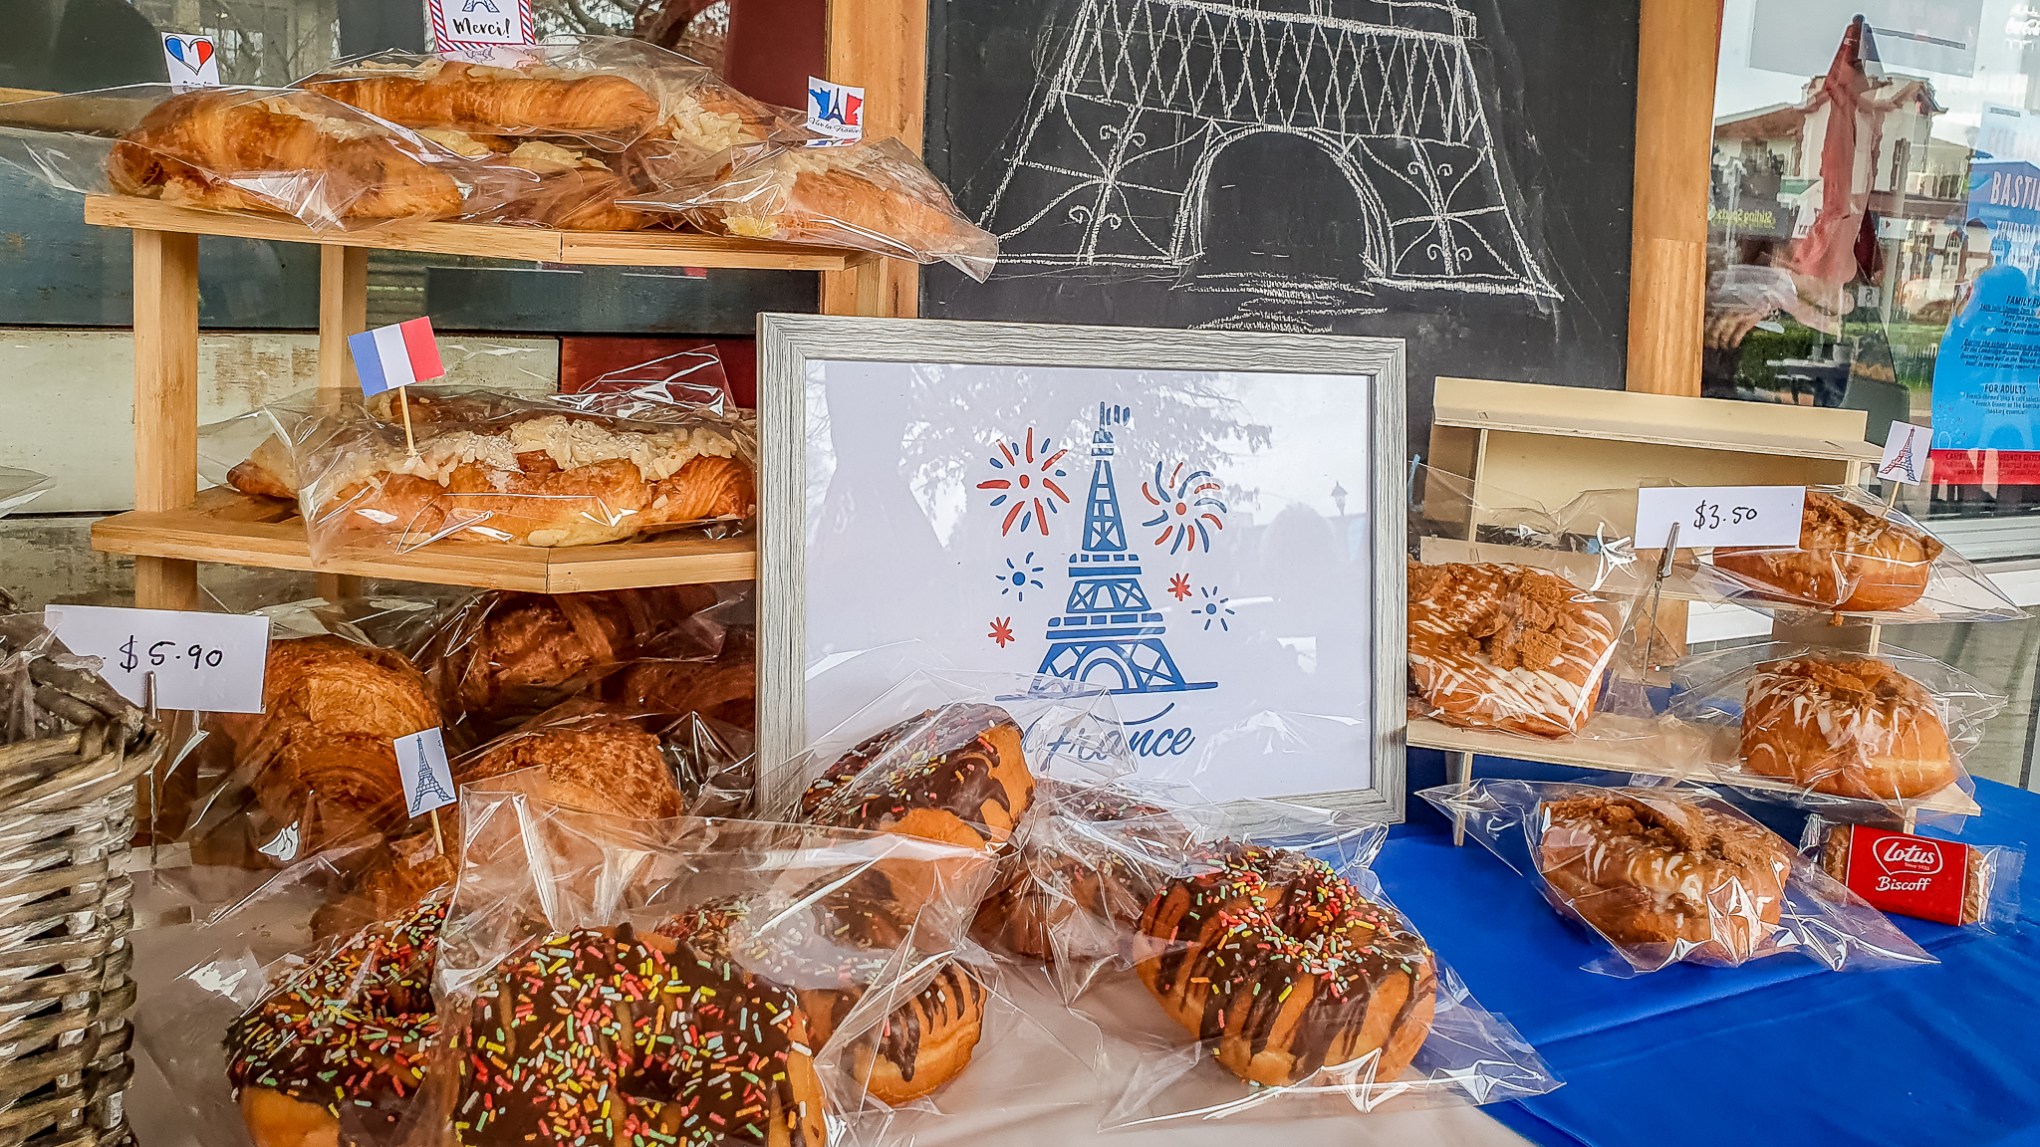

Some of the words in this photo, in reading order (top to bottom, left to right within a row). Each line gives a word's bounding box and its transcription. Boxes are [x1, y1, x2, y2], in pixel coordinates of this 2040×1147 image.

[452, 17, 511, 39] Merci!
[2006, 295, 2032, 306] FAMILY
[1984, 383, 1998, 393] FOR
[1999, 384, 2027, 394] ADULTS
[1693, 499, 1758, 530] $3.50
[119, 634, 223, 673] $5.90
[1023, 714, 1196, 772] France
[1884, 842, 1935, 864] Lotus
[1875, 875, 1932, 891] Biscoff
